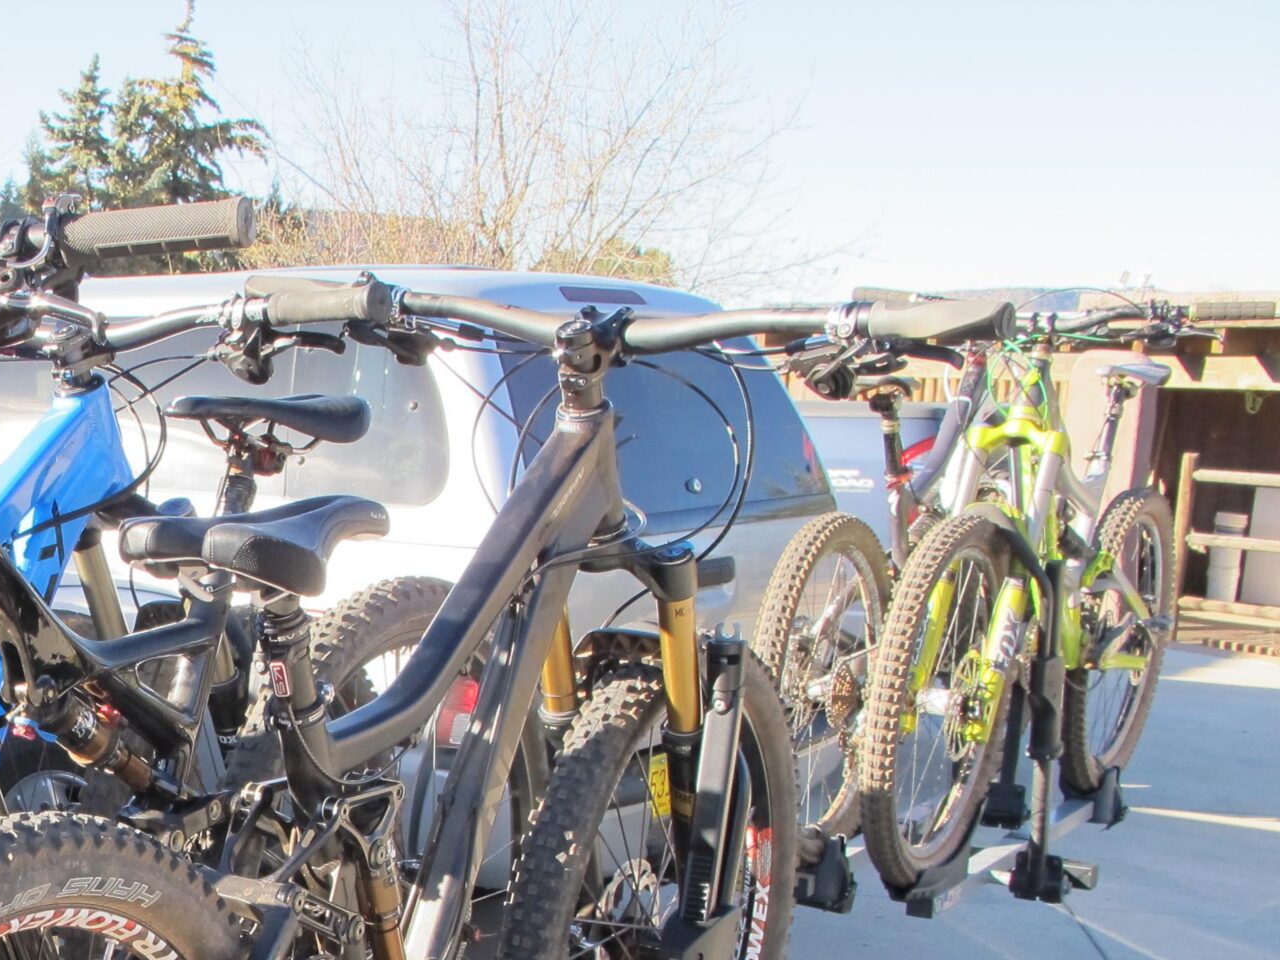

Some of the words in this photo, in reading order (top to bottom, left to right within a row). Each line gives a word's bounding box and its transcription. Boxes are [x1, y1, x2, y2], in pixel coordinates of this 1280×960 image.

[56, 877, 162, 908] HANS
[754, 880, 771, 922] EX
[7, 909, 56, 934] EX
[49, 908, 144, 943] FLOW
